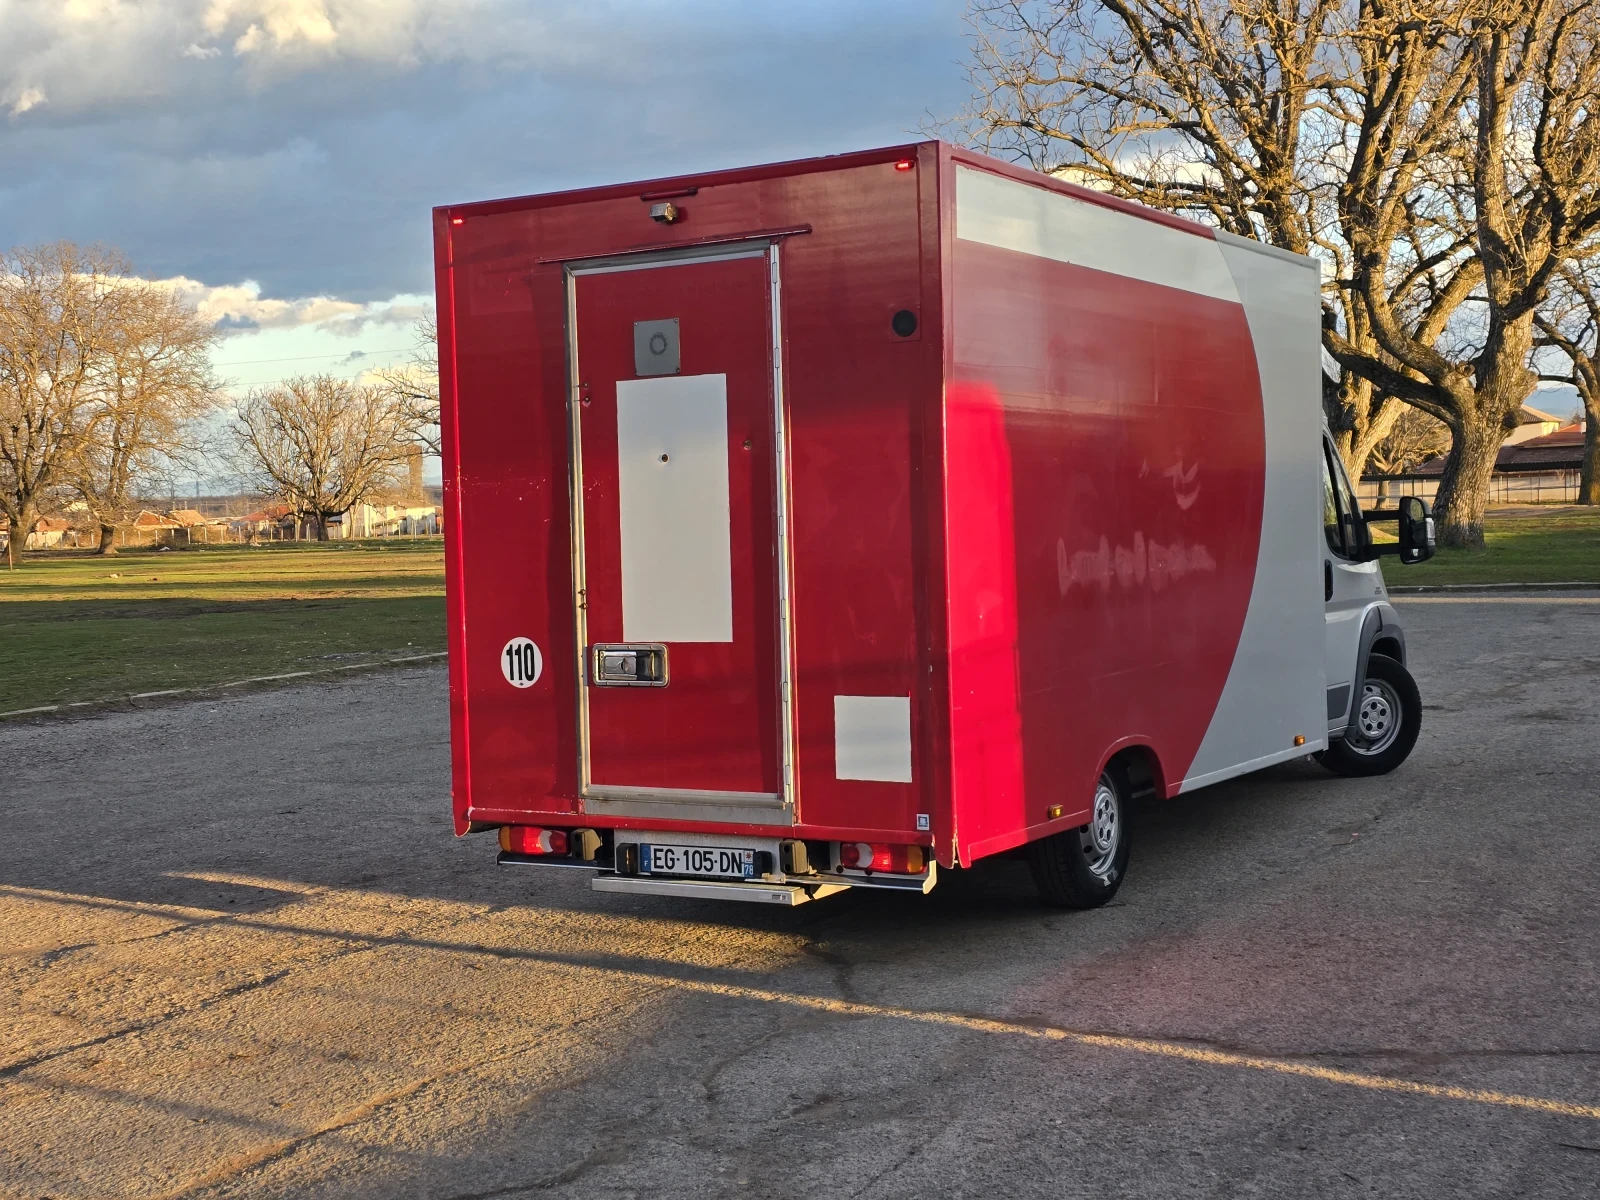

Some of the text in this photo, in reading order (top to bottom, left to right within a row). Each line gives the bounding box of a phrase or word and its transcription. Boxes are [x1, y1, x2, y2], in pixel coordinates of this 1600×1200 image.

[506, 643, 535, 681] 110
[653, 848, 743, 874] EG-105-DN
[744, 865, 754, 875] 78
